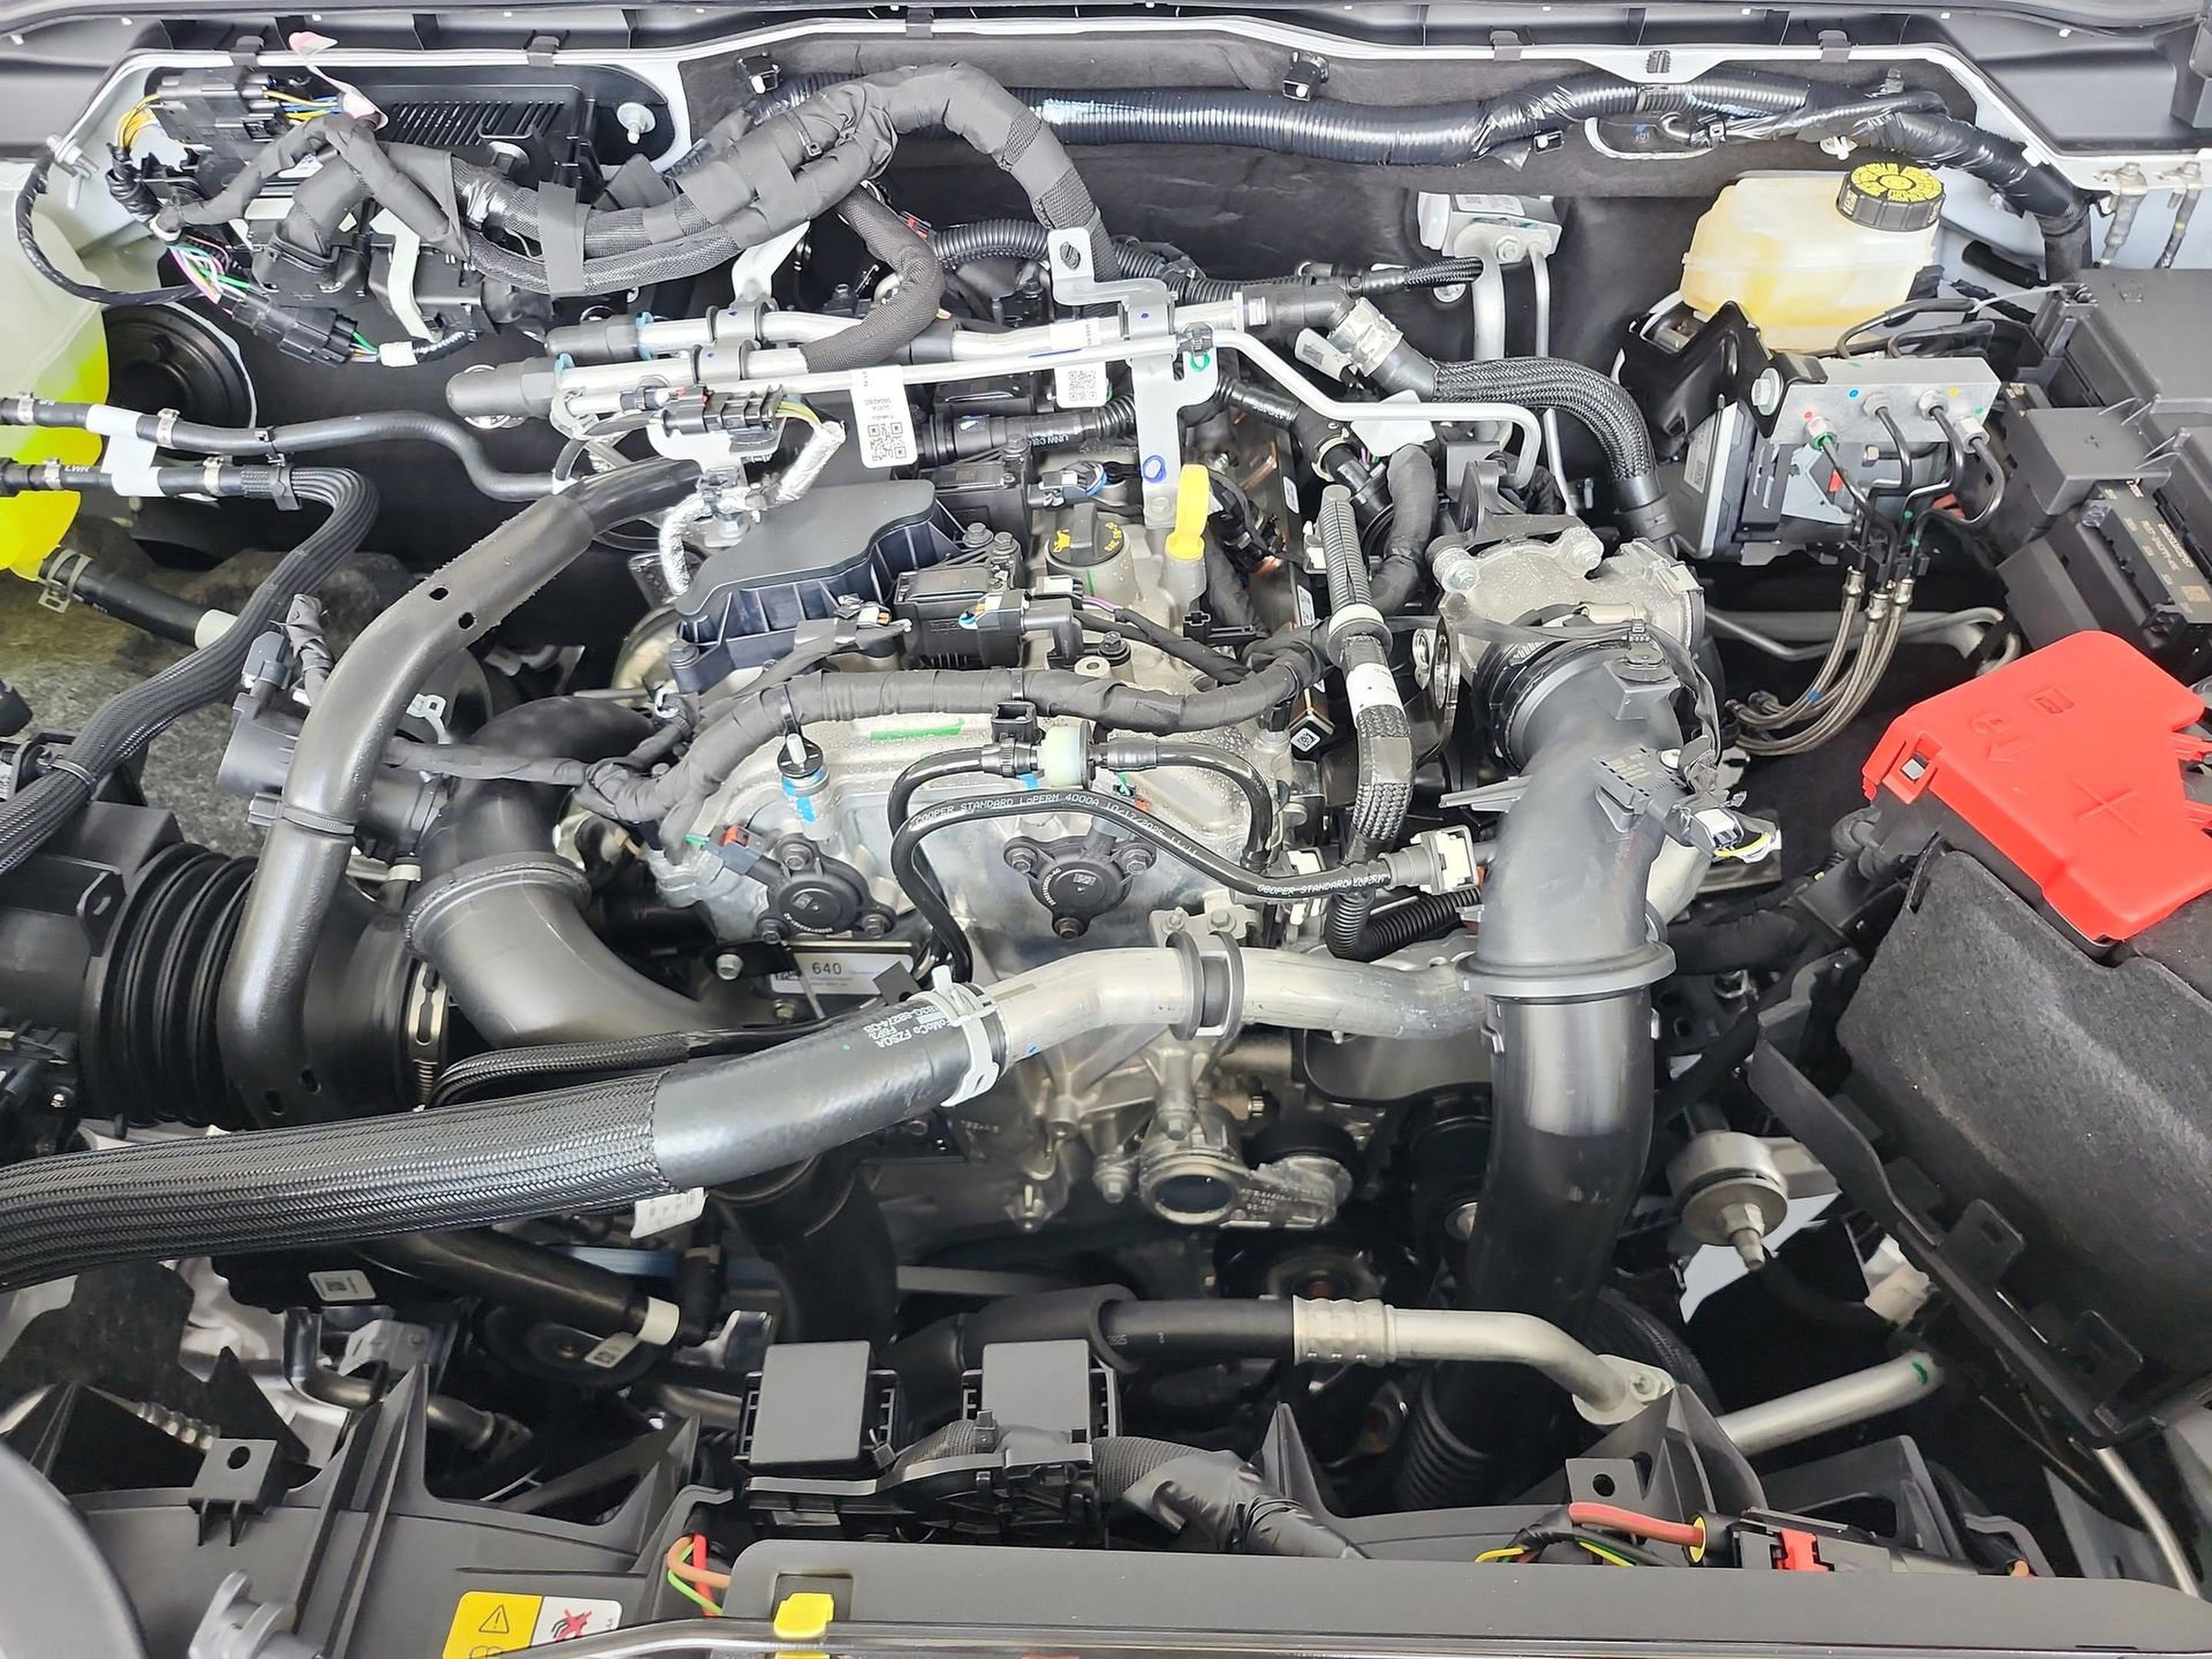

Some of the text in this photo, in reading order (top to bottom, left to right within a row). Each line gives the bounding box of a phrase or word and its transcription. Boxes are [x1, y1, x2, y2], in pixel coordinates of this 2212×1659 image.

[915, 805, 955, 824] COOPER
[960, 798, 1014, 812] STANDARD
[812, 962, 843, 975] 640
